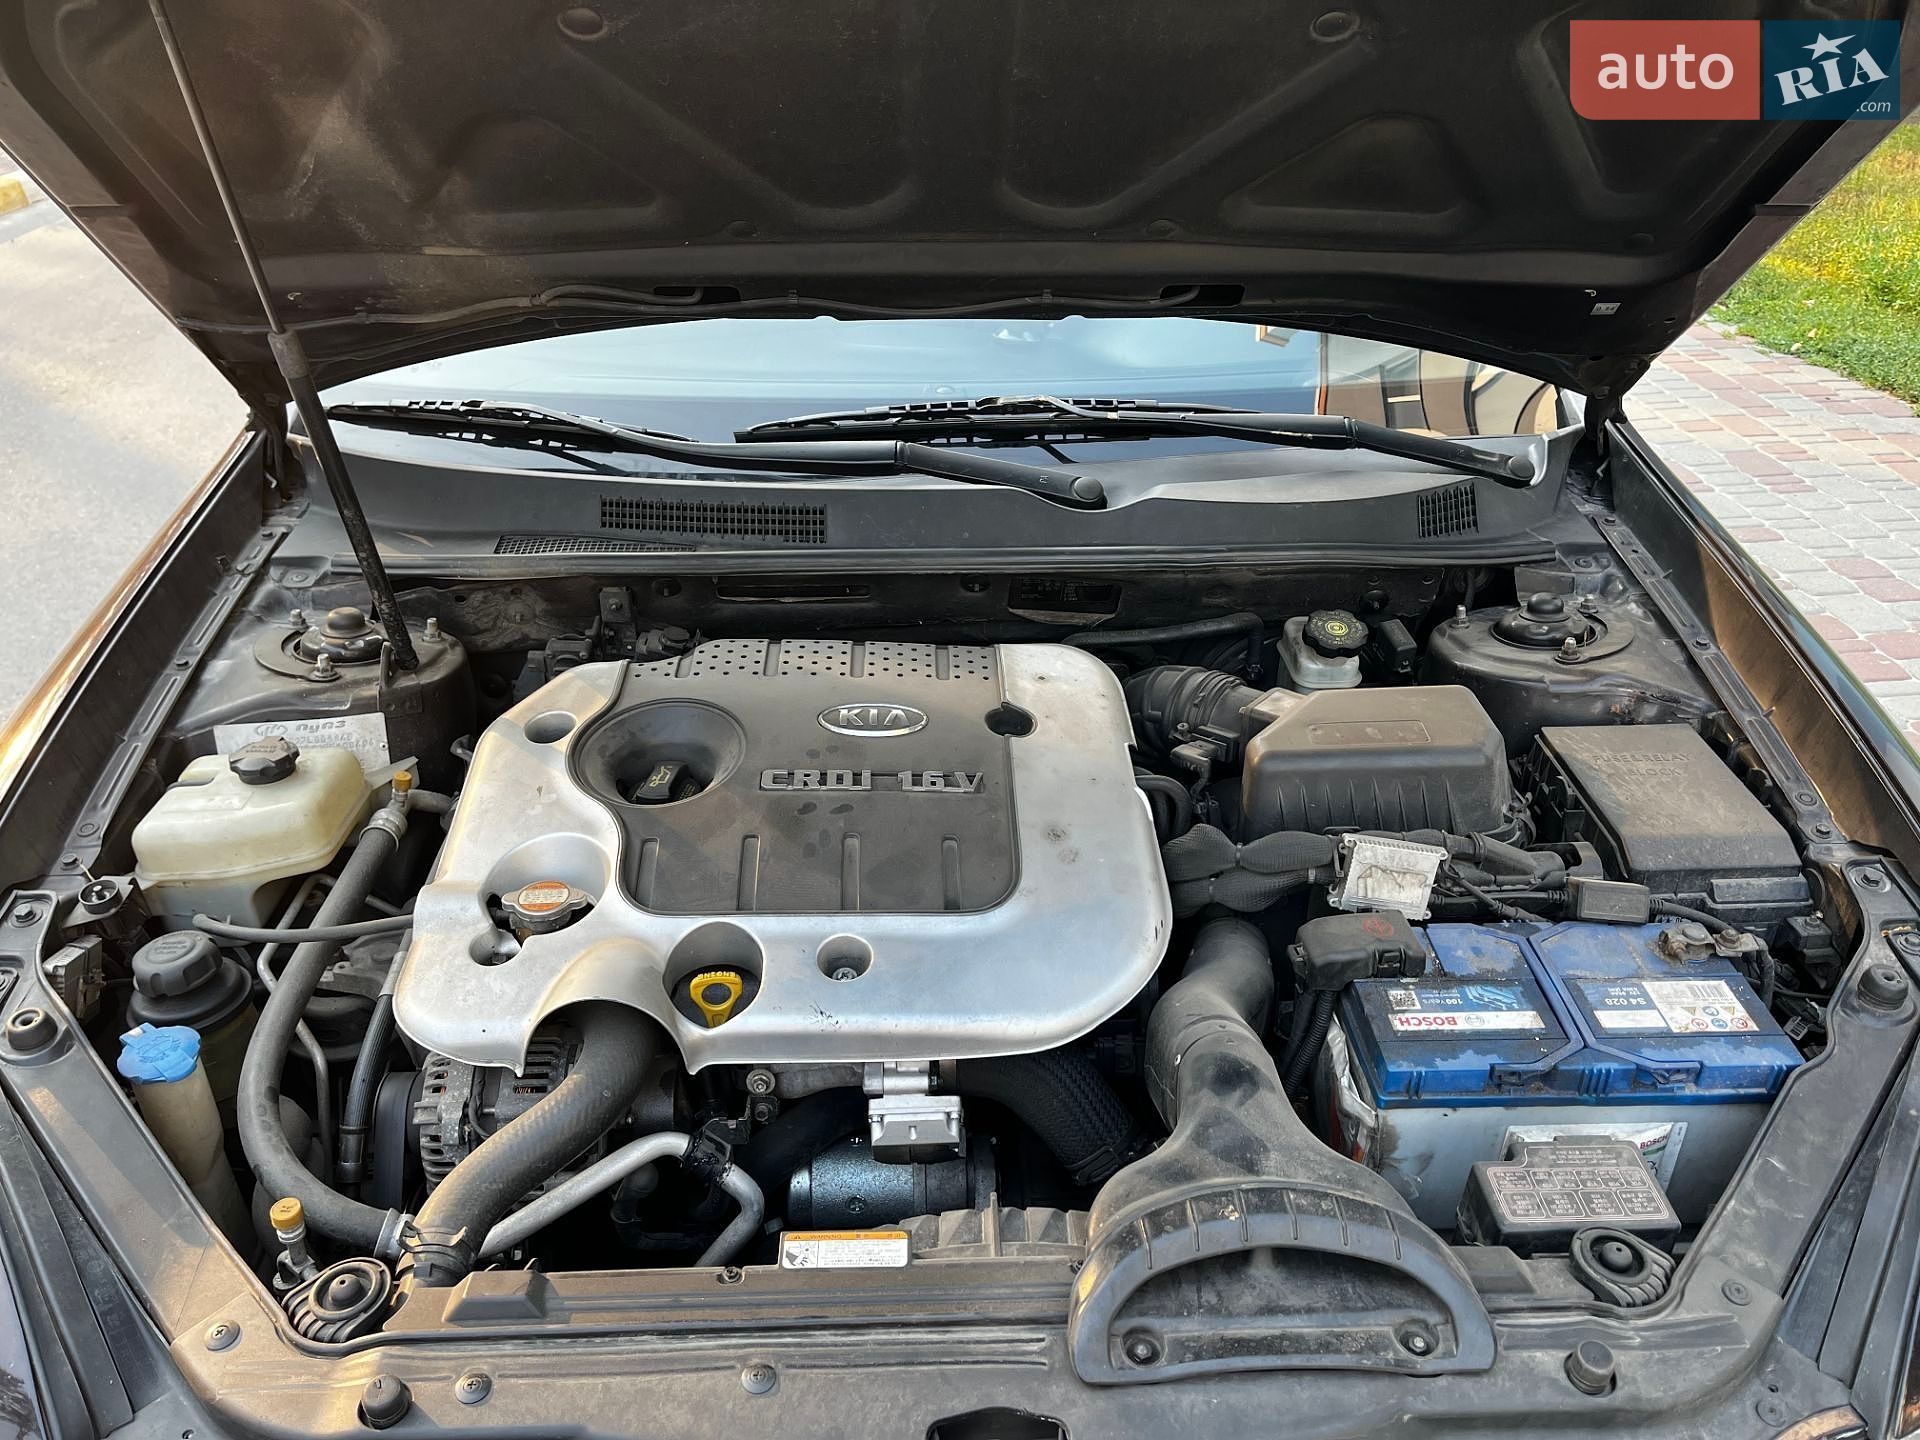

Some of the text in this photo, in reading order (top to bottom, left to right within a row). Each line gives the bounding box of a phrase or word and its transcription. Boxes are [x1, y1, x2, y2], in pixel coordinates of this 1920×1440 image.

[838, 708, 911, 727] KIA
[1397, 1016, 1458, 1027] BOSCH
[1640, 1133, 1668, 1149] BOSCH
